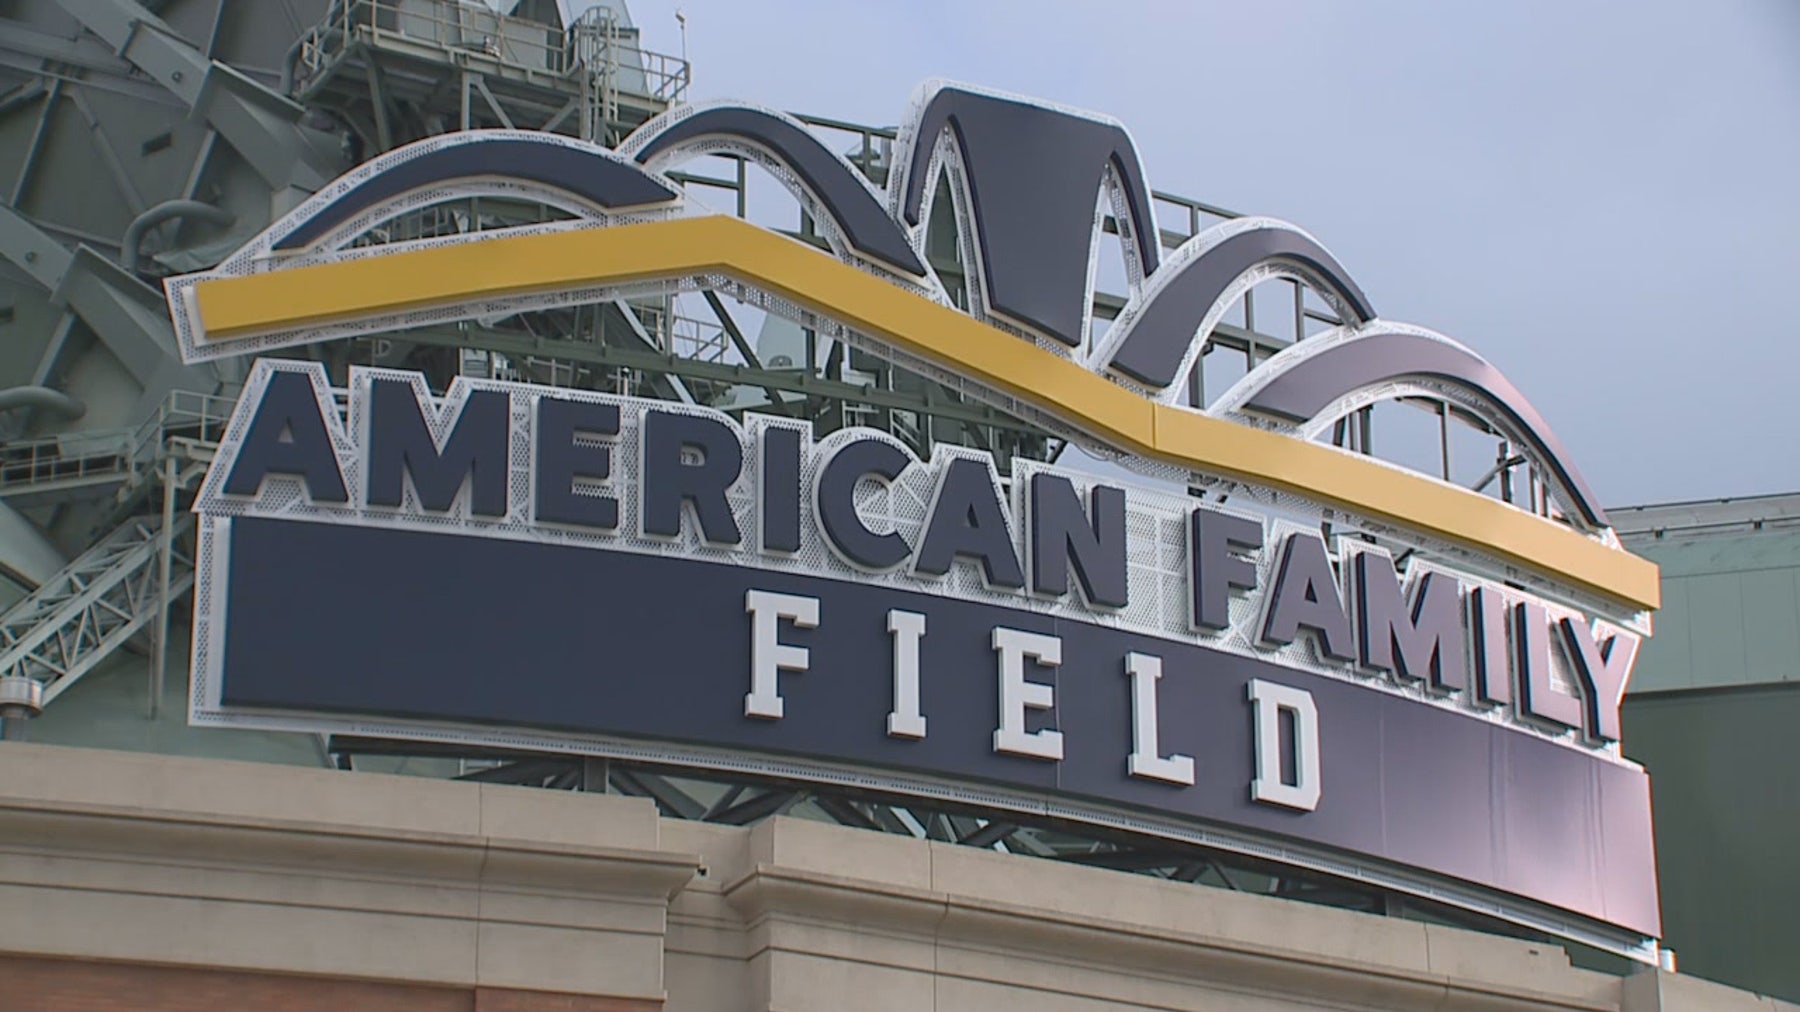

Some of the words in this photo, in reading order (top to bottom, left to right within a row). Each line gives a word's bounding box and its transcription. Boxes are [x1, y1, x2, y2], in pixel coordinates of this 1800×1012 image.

[222, 369, 1127, 608] AMERICAN
[1193, 507, 1638, 742] FAMILY
[744, 589, 1321, 811] FIELD
